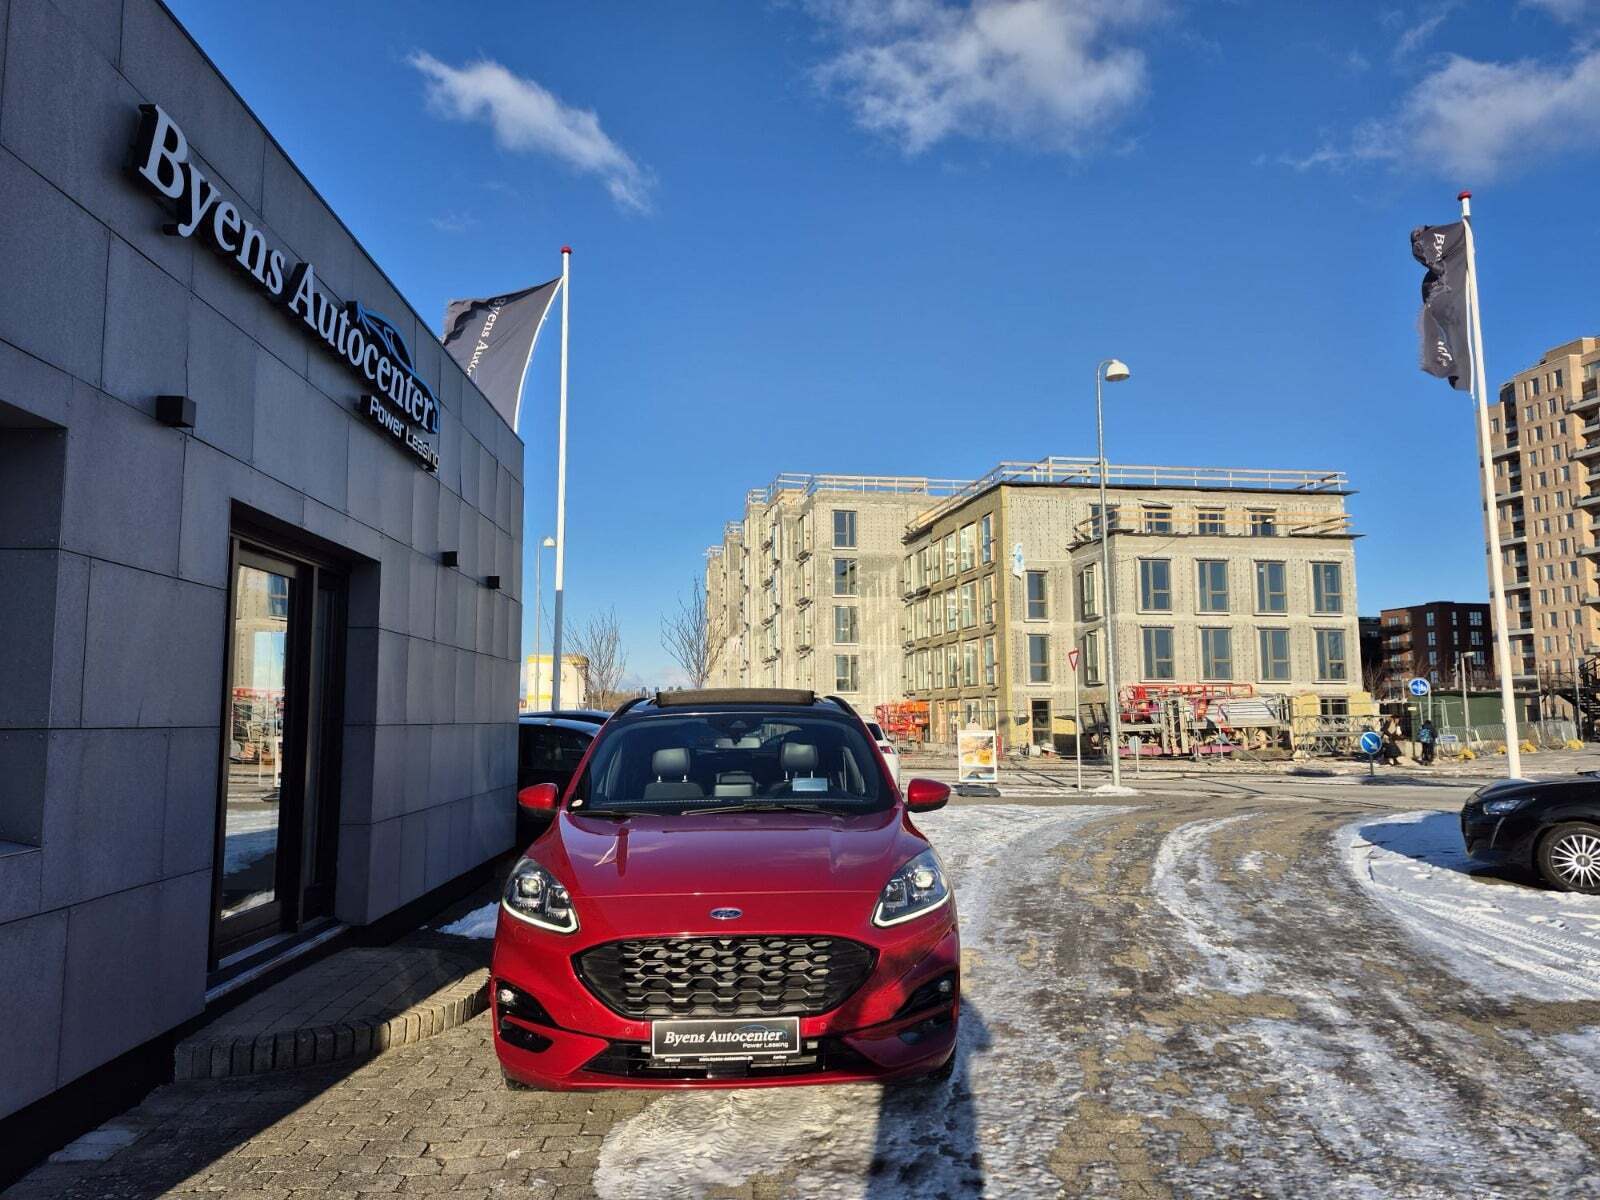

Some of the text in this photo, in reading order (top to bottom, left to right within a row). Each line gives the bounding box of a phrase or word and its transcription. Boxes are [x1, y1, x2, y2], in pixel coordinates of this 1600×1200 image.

[138, 104, 435, 430] Byens Autocenter
[369, 395, 440, 473] Power Leasing
[664, 1030, 783, 1047] Byens Autocenter
[763, 1041, 789, 1049] Leasing
